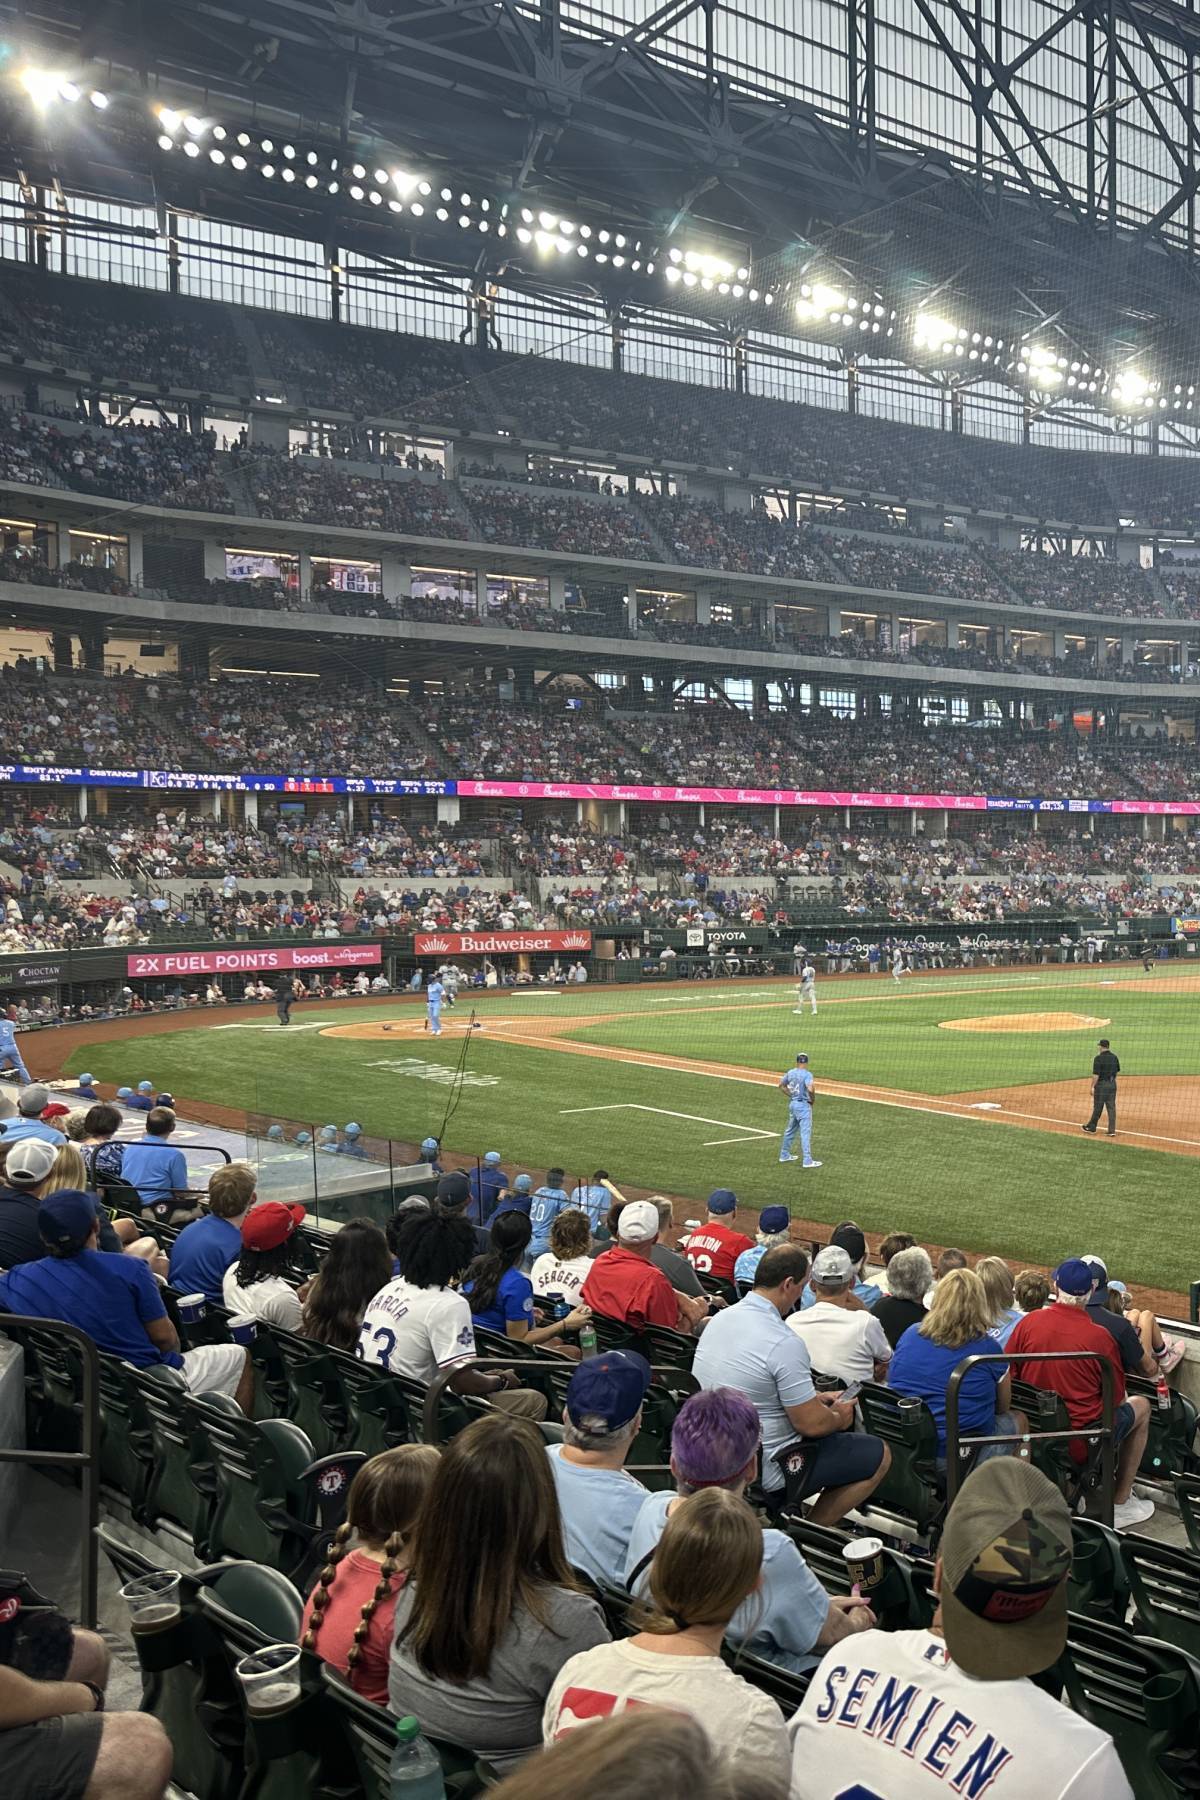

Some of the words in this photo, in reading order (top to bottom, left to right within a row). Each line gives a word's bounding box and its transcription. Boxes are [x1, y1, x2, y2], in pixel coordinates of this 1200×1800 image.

[23, 766, 46, 774] EXIT
[48, 768, 81, 776] ANGLE
[89, 769, 138, 778] DISTANCE
[168, 773, 197, 781] ALEC
[198, 774, 241, 782] MARSH
[460, 936, 551, 952] Budweiser
[707, 931, 746, 941] TOYOTA
[136, 958, 159, 973] 2X
[166, 956, 210, 971] FUEL
[216, 953, 278, 968] POINTS
[293, 951, 328, 964] boost
[23, 967, 60, 977] CHOCTAW
[530, 1203, 545, 1221] 20
[538, 1270, 580, 1290] SEAGER
[816, 1665, 1014, 1800] SEMIEN
